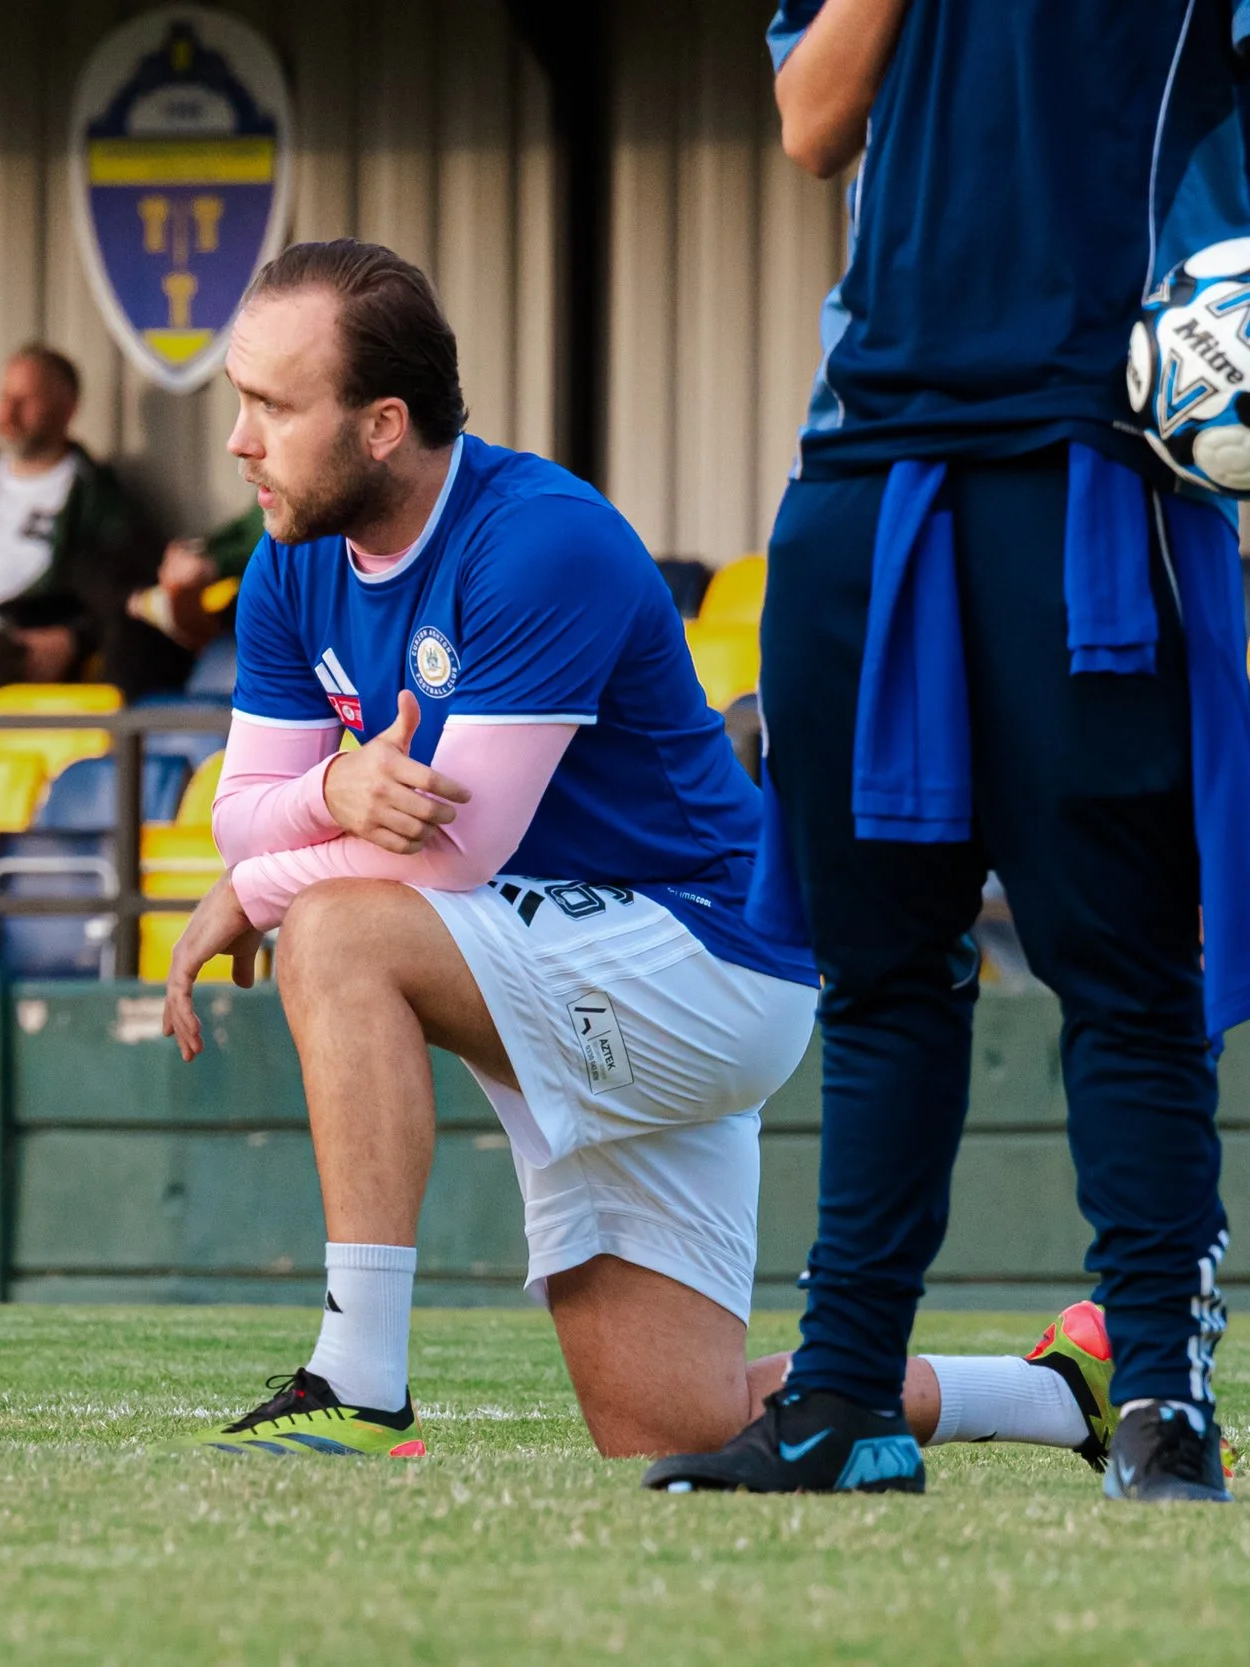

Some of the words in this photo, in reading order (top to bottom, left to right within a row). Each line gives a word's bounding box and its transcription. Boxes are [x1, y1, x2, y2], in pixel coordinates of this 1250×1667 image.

[1172, 317, 1245, 386] Mitre
[411, 629, 428, 657] CURZON
[428, 629, 452, 654] ASHTON
[415, 672, 448, 695] FOOTBALL
[446, 667, 458, 689] CLUB
[599, 1039, 616, 1071] AZTEK
